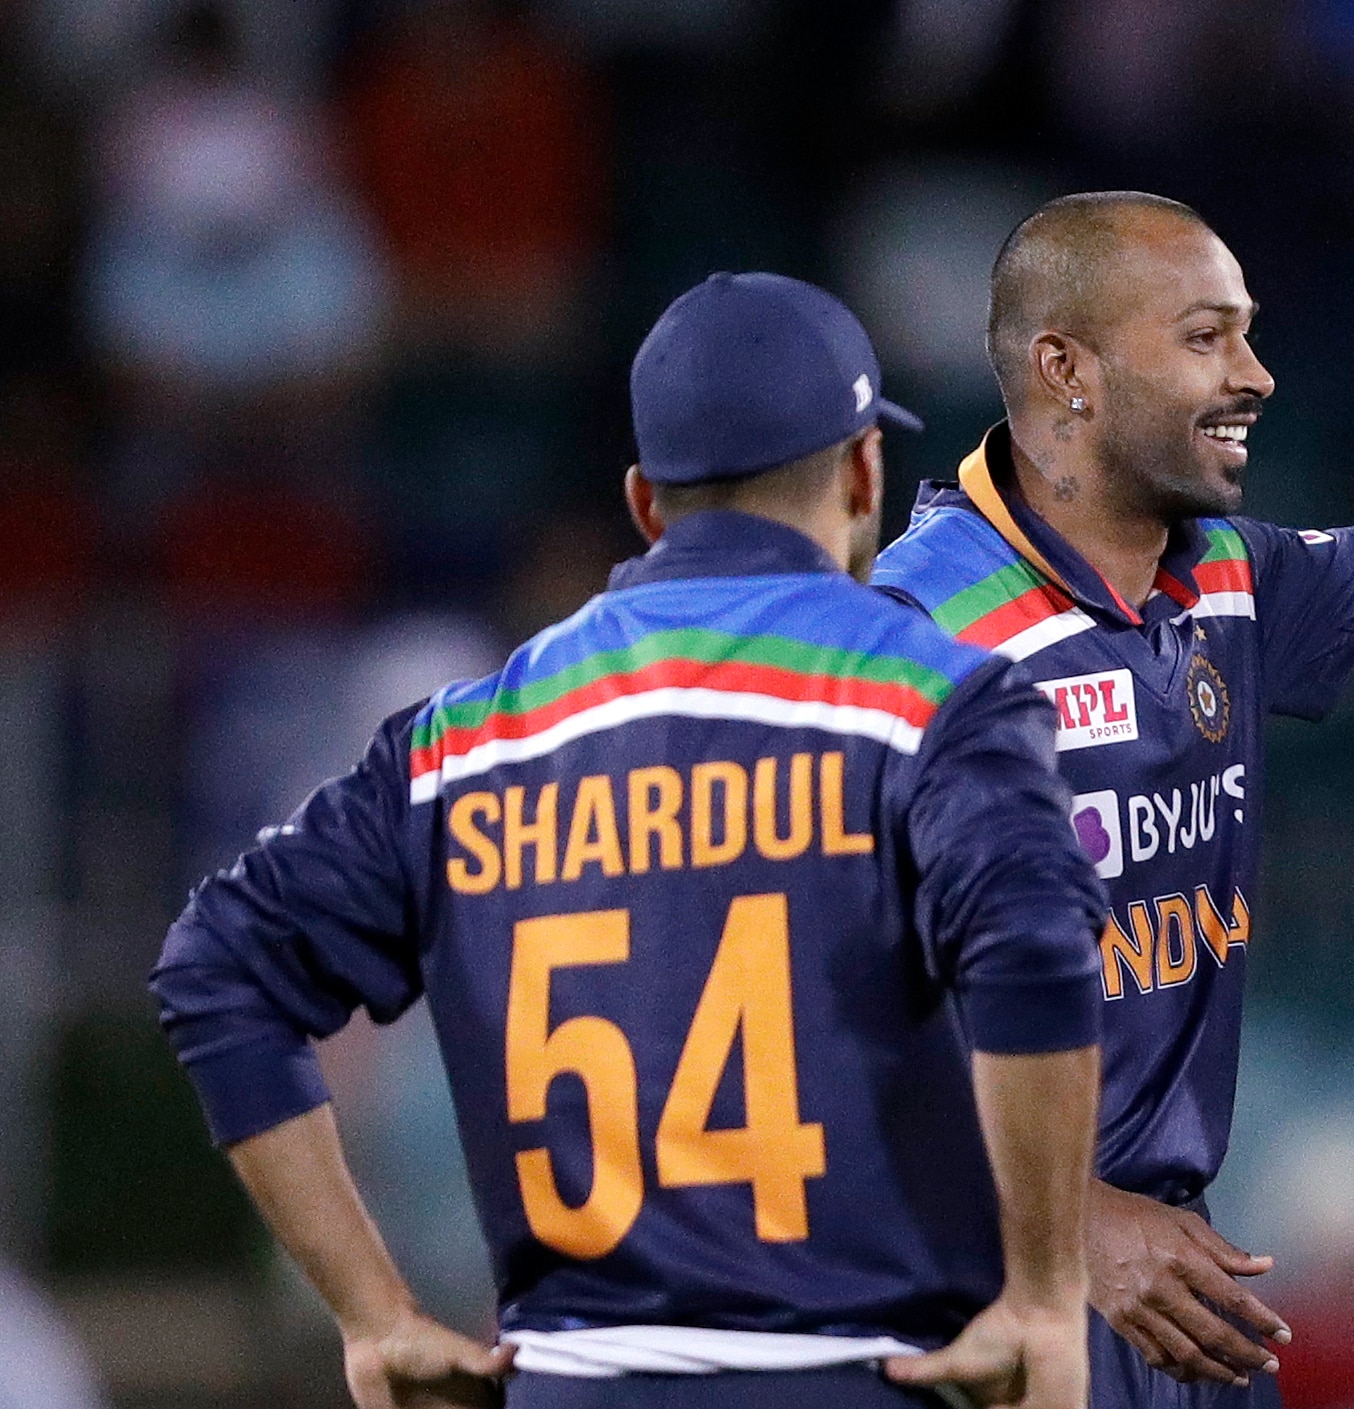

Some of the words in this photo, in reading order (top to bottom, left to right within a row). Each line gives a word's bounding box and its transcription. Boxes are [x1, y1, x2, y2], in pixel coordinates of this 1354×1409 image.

[1089, 723, 1132, 739] SPORTS
[447, 752, 874, 894] SHARDUL
[506, 893, 826, 1260] 54
